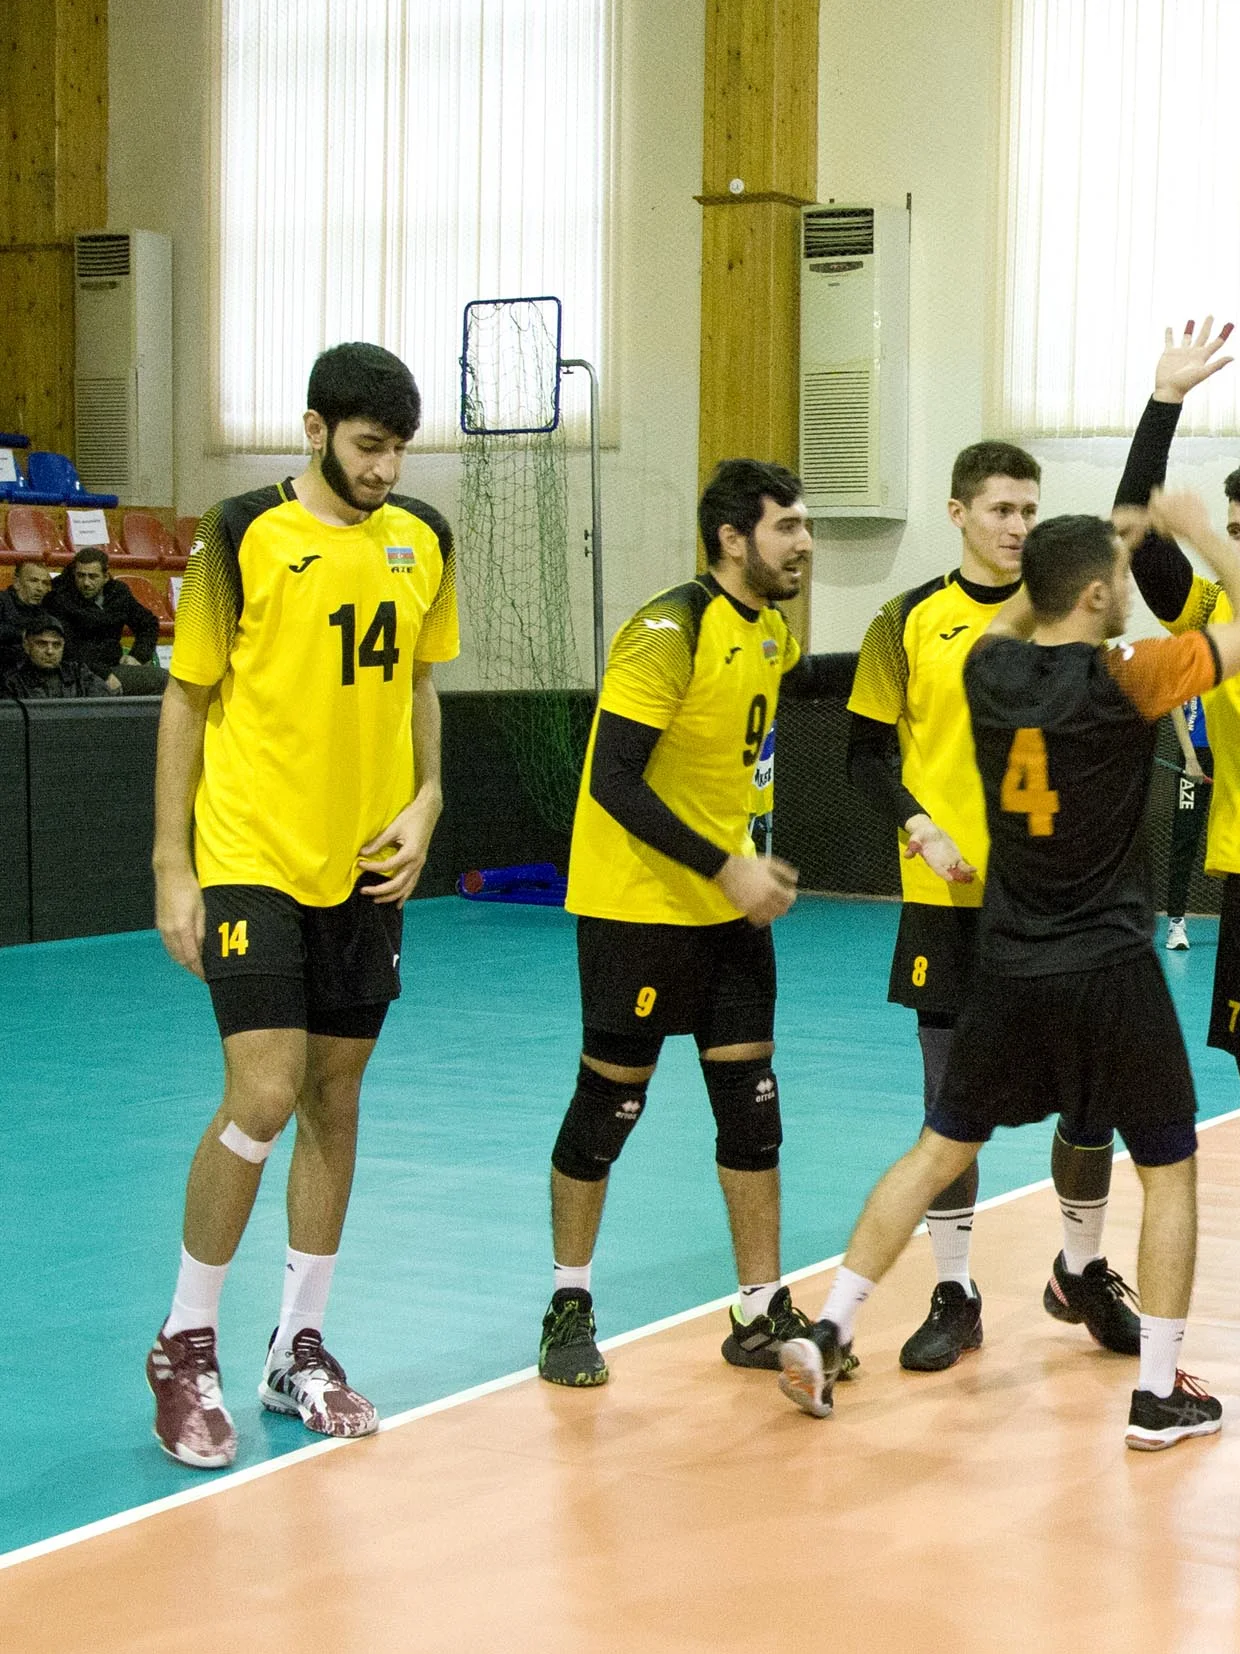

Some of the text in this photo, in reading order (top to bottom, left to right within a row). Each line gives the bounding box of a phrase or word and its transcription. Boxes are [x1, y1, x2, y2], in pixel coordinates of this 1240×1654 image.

[329, 600, 400, 685] 14
[743, 694, 768, 767] 9
[1001, 728, 1060, 834] 4
[1180, 778, 1195, 810] AZE
[218, 920, 249, 957] 14
[912, 955, 928, 987] 8
[635, 986, 657, 1017] 9
[1229, 1000, 1240, 1033] 7
